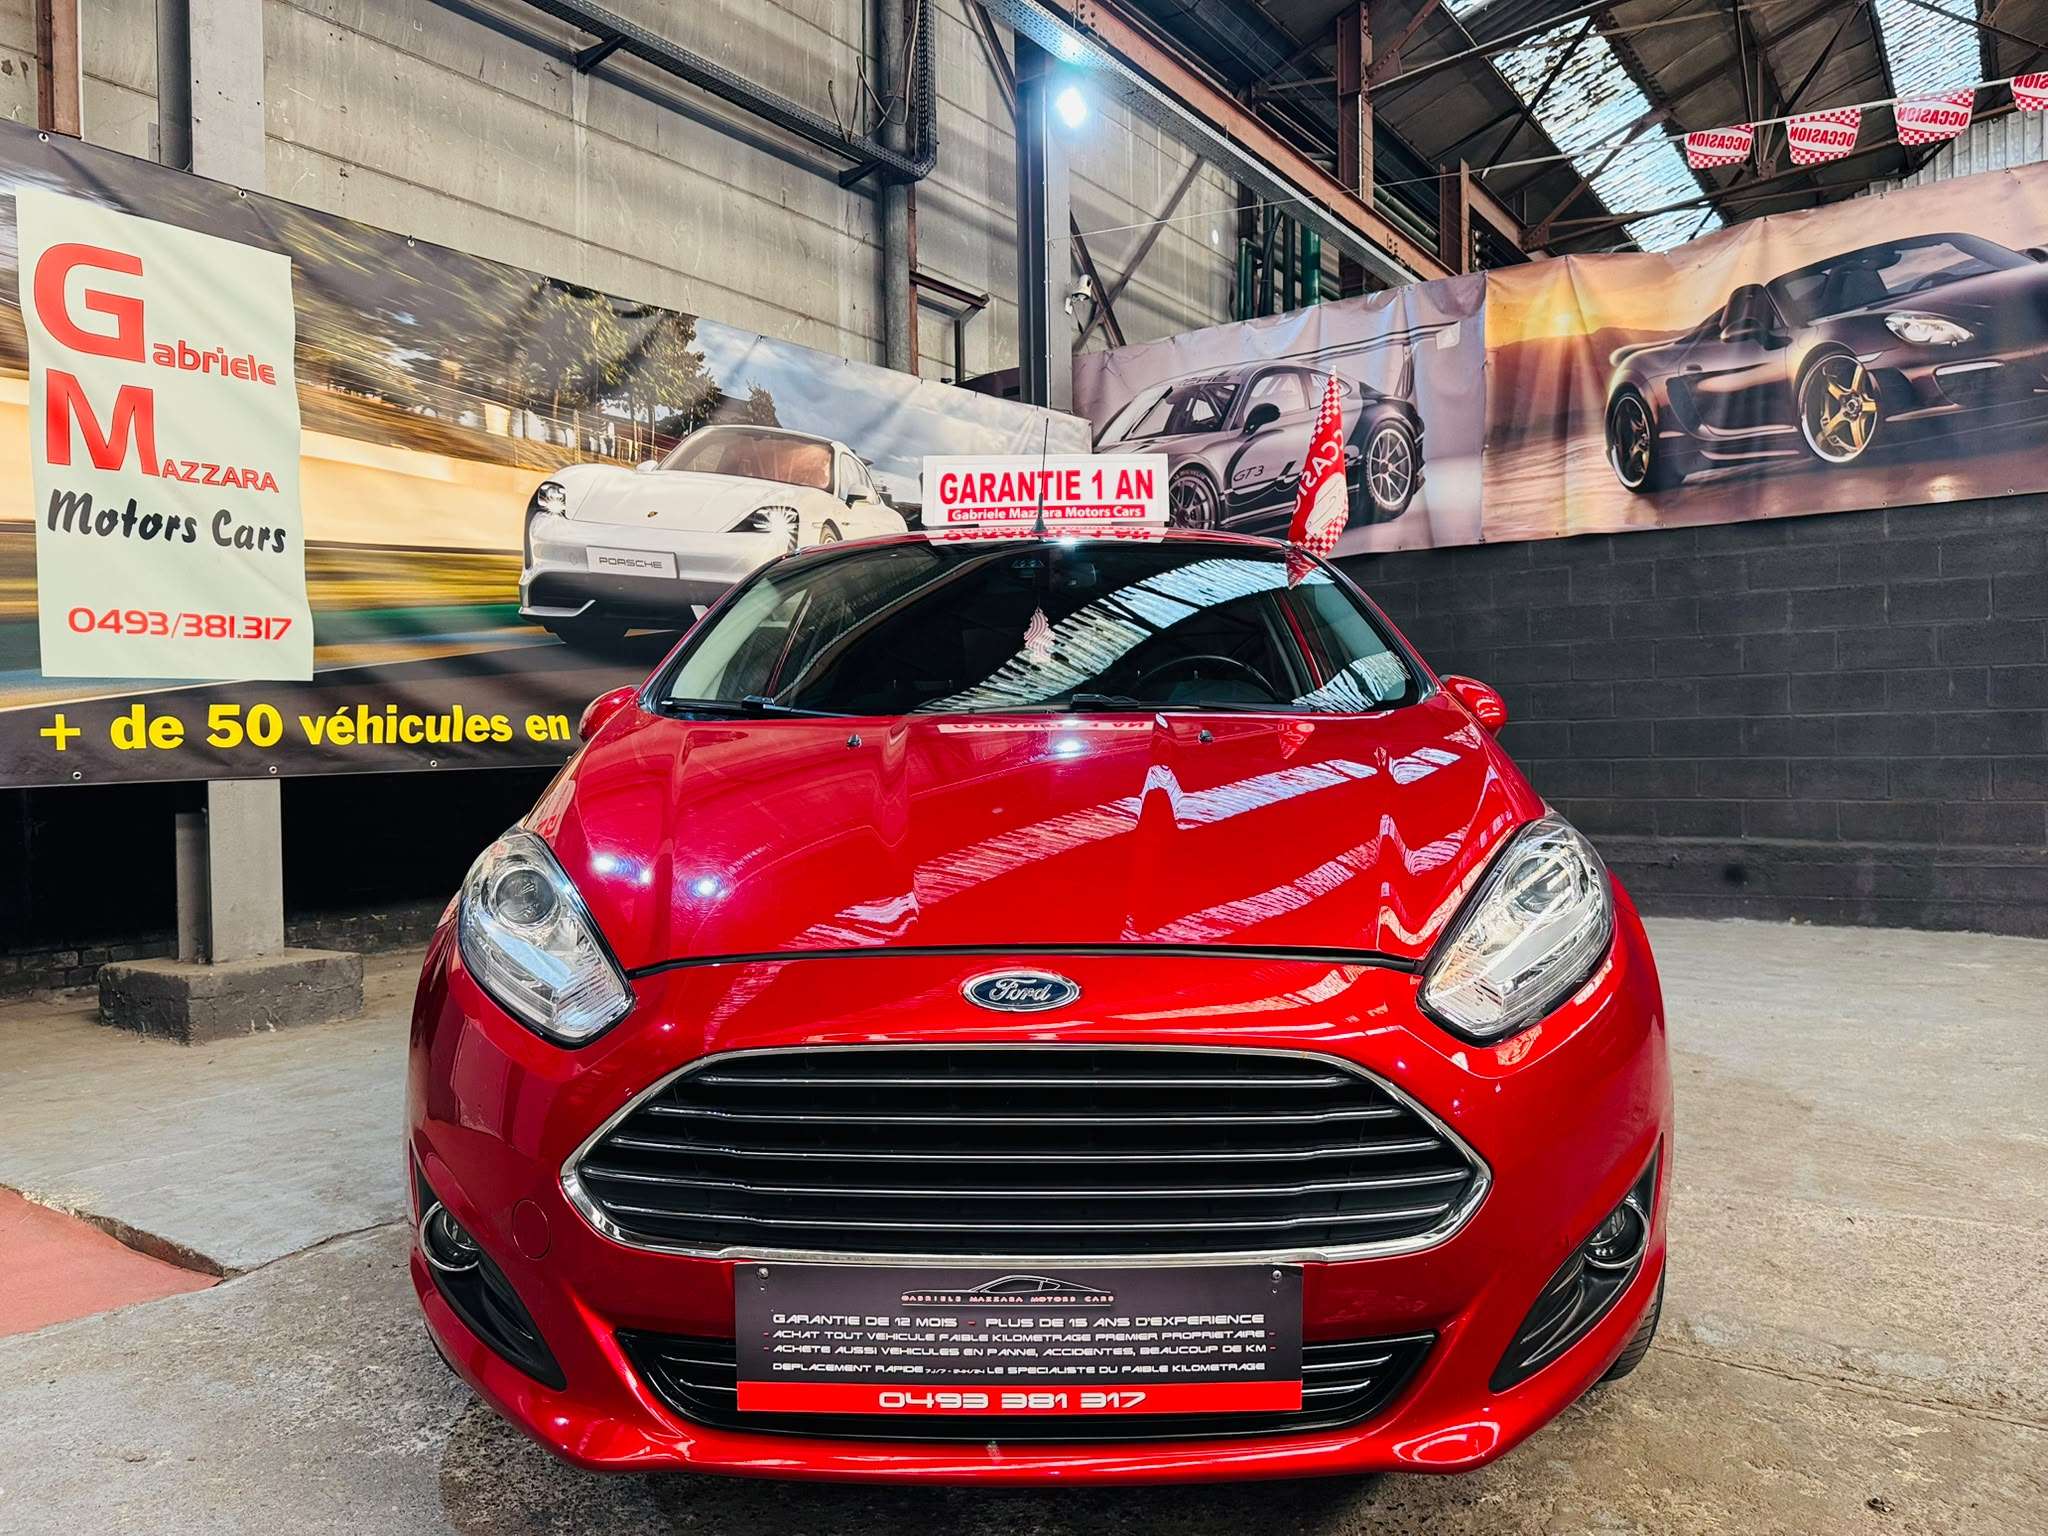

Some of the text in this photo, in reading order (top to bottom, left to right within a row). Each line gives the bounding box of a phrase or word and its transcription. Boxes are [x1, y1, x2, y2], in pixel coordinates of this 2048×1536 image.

[1233, 464, 1264, 482] GT3
[939, 469, 1154, 505] GARANTIE 1 AN
[48, 488, 287, 553] Motors Cars
[951, 508, 1006, 520] Gabriele
[1065, 506, 1111, 518] Motors
[1113, 505, 1141, 517] Cars
[599, 557, 662, 569] PORSCHE
[68, 607, 292, 640] 0493/381.317
[110, 704, 185, 749] de
[206, 704, 284, 748] 50
[299, 704, 513, 746] véhicules
[525, 713, 571, 741] en
[988, 978, 1053, 1001] Ford
[772, 1314, 860, 1326] GARANTIE
[865, 1316, 890, 1327] DE
[895, 1317, 911, 1327] 12
[915, 1317, 958, 1328] MOIS
[985, 1318, 1034, 1328] PLUS
[1039, 1318, 1064, 1328] DE
[1069, 1318, 1088, 1328] 15
[1093, 1317, 1131, 1328] ANS
[1135, 1314, 1265, 1327] D'EXPERIENCE
[772, 1330, 1265, 1342] ACHAT TOUT VEHICULE FAIBLE KILOMETRAGE PREMIER PROPRIETAIRE
[773, 1345, 831, 1354] ACHETE
[834, 1346, 878, 1355] AUSSI
[881, 1347, 960, 1356] VEHICULES
[963, 1348, 984, 1356] EN
[987, 1348, 1039, 1357] PANNE,
[1139, 1345, 1218, 1355] BEAUCOUP
[1222, 1345, 1242, 1353] DE
[1245, 1344, 1267, 1353] KM
[772, 1363, 872, 1373] DEPLACEMENT
[875, 1365, 924, 1374] RAPIDE
[1007, 1366, 1096, 1375] SPECIALISTE
[1099, 1366, 1118, 1374] DU
[1172, 1362, 1265, 1372] KILOMETRAGE
[878, 1391, 1146, 1409] 0493 381 317
